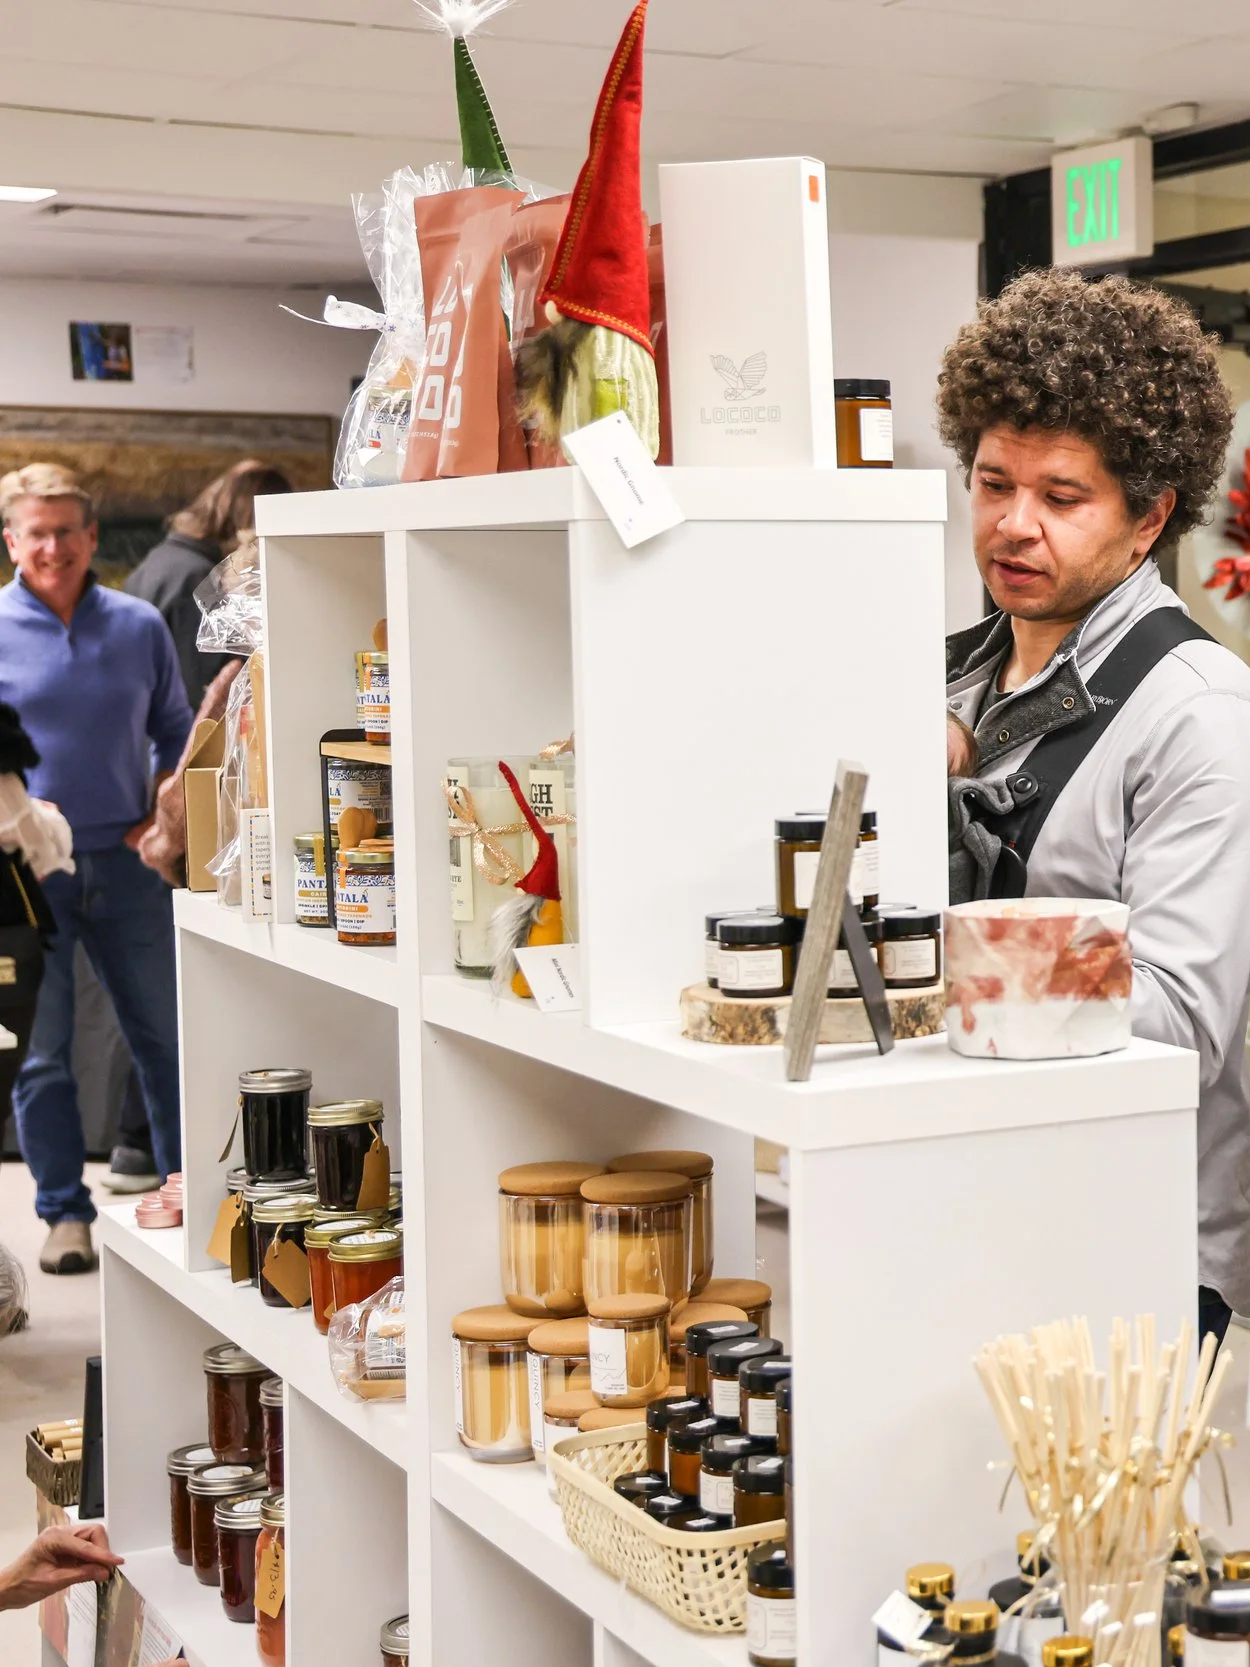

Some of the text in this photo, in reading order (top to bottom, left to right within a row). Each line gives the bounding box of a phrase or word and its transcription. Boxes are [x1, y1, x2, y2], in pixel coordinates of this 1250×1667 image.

[1066, 158, 1122, 247] EXIT
[701, 406, 781, 424] LOCOCO
[627, 480, 644, 505] Gnome
[533, 1358, 541, 1410] QUINCY
